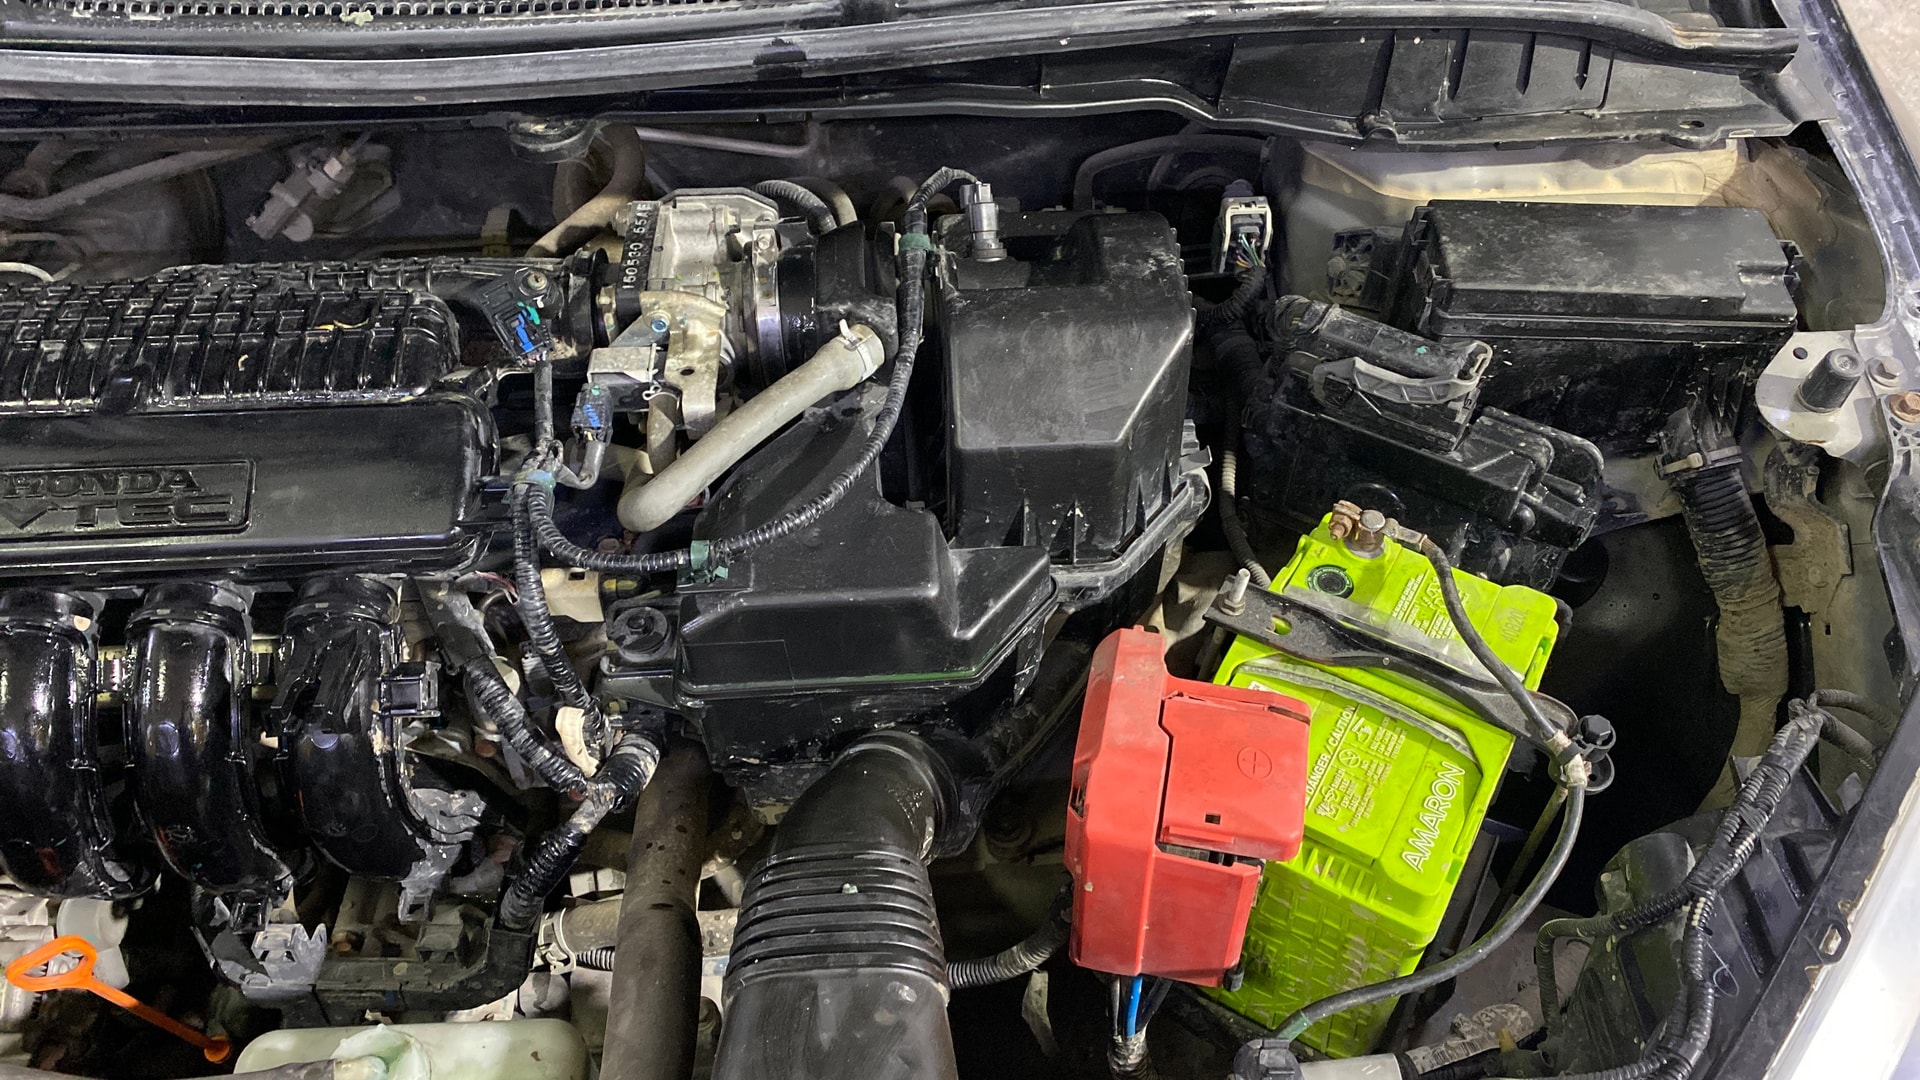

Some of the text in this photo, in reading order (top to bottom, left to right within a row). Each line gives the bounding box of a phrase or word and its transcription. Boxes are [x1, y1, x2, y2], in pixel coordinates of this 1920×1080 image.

[2, 468, 204, 499] HONDA
[1307, 755, 1331, 795] DANGER
[1329, 706, 1355, 747] CAUTION
[1402, 761, 1465, 872] AMARON
